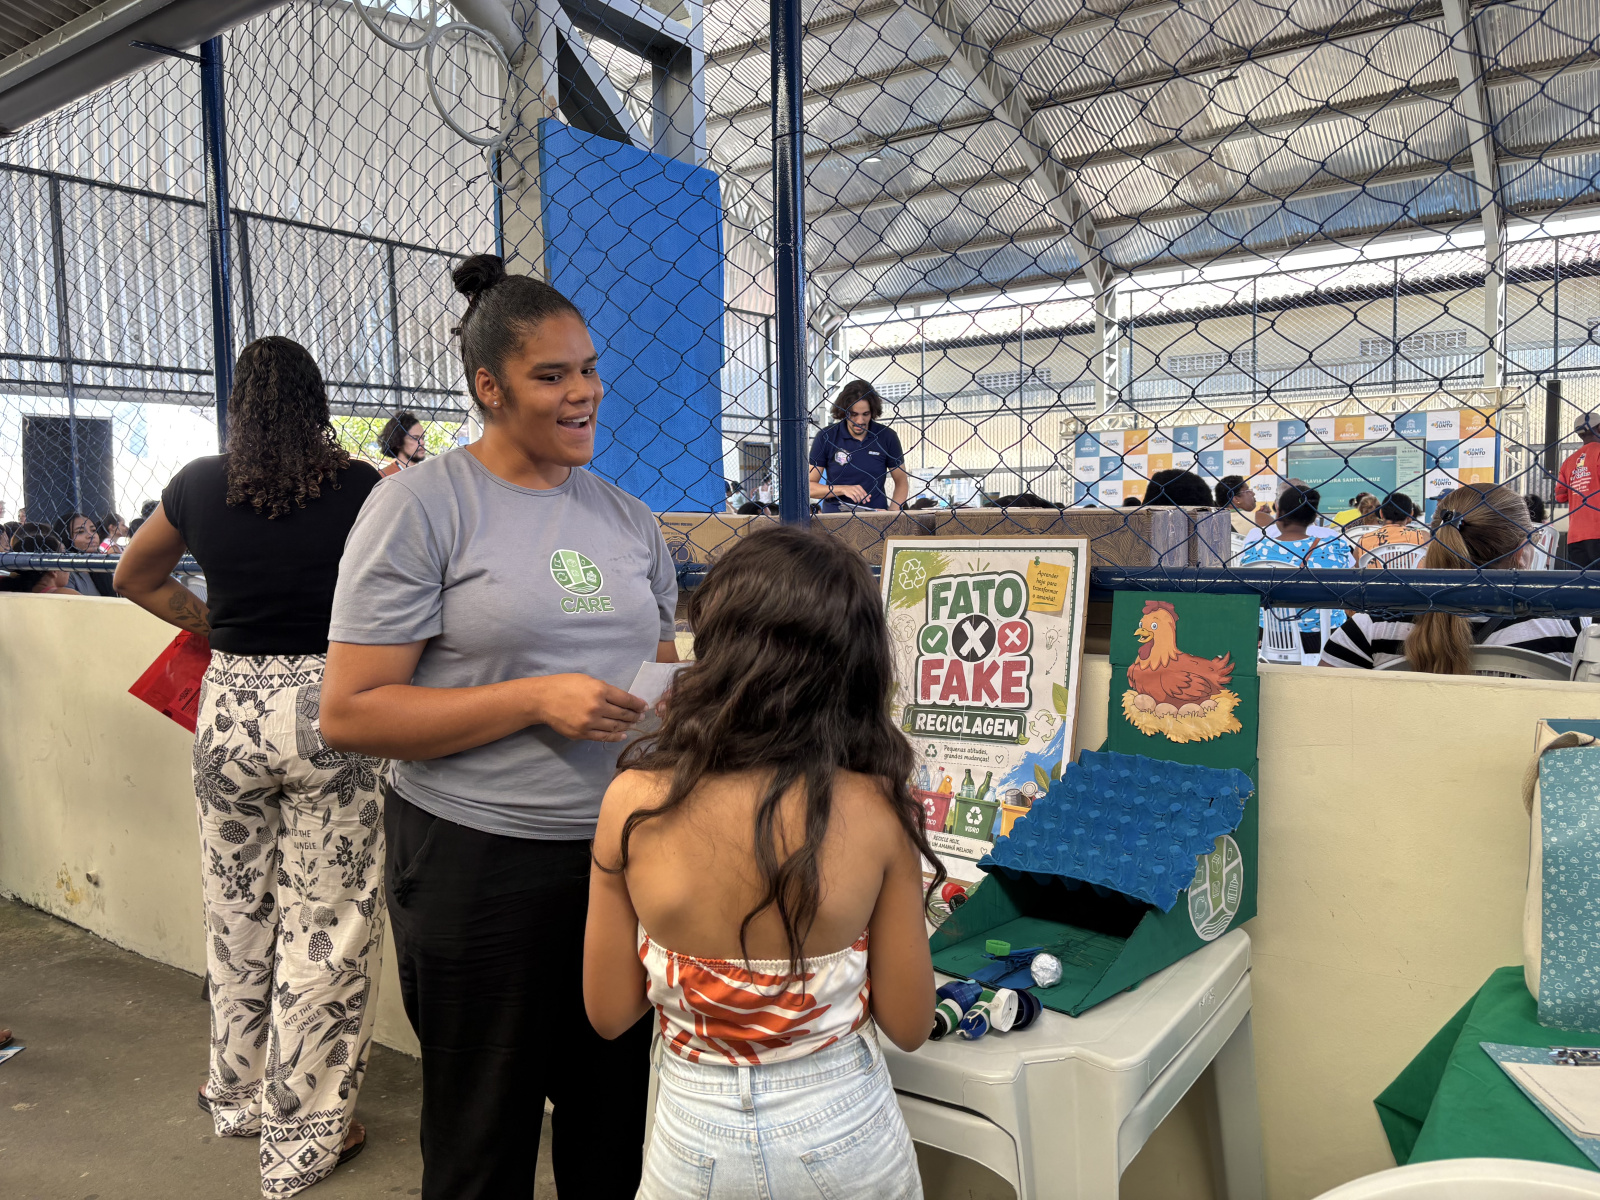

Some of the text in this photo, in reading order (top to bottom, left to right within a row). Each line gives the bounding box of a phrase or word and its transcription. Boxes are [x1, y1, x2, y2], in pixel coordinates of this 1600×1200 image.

[560, 596, 615, 614] CARE
[931, 577, 1023, 620] FATO
[920, 658, 1026, 703] FAKE
[915, 713, 1019, 738] RECICLAGEM
[944, 745, 988, 755] Pequenas atitudes,
[299, 829, 312, 838] THE
[965, 825, 980, 834] VIDRO
[283, 1002, 314, 1028] INTO THE
[296, 1009, 322, 1034] JUNGLE
